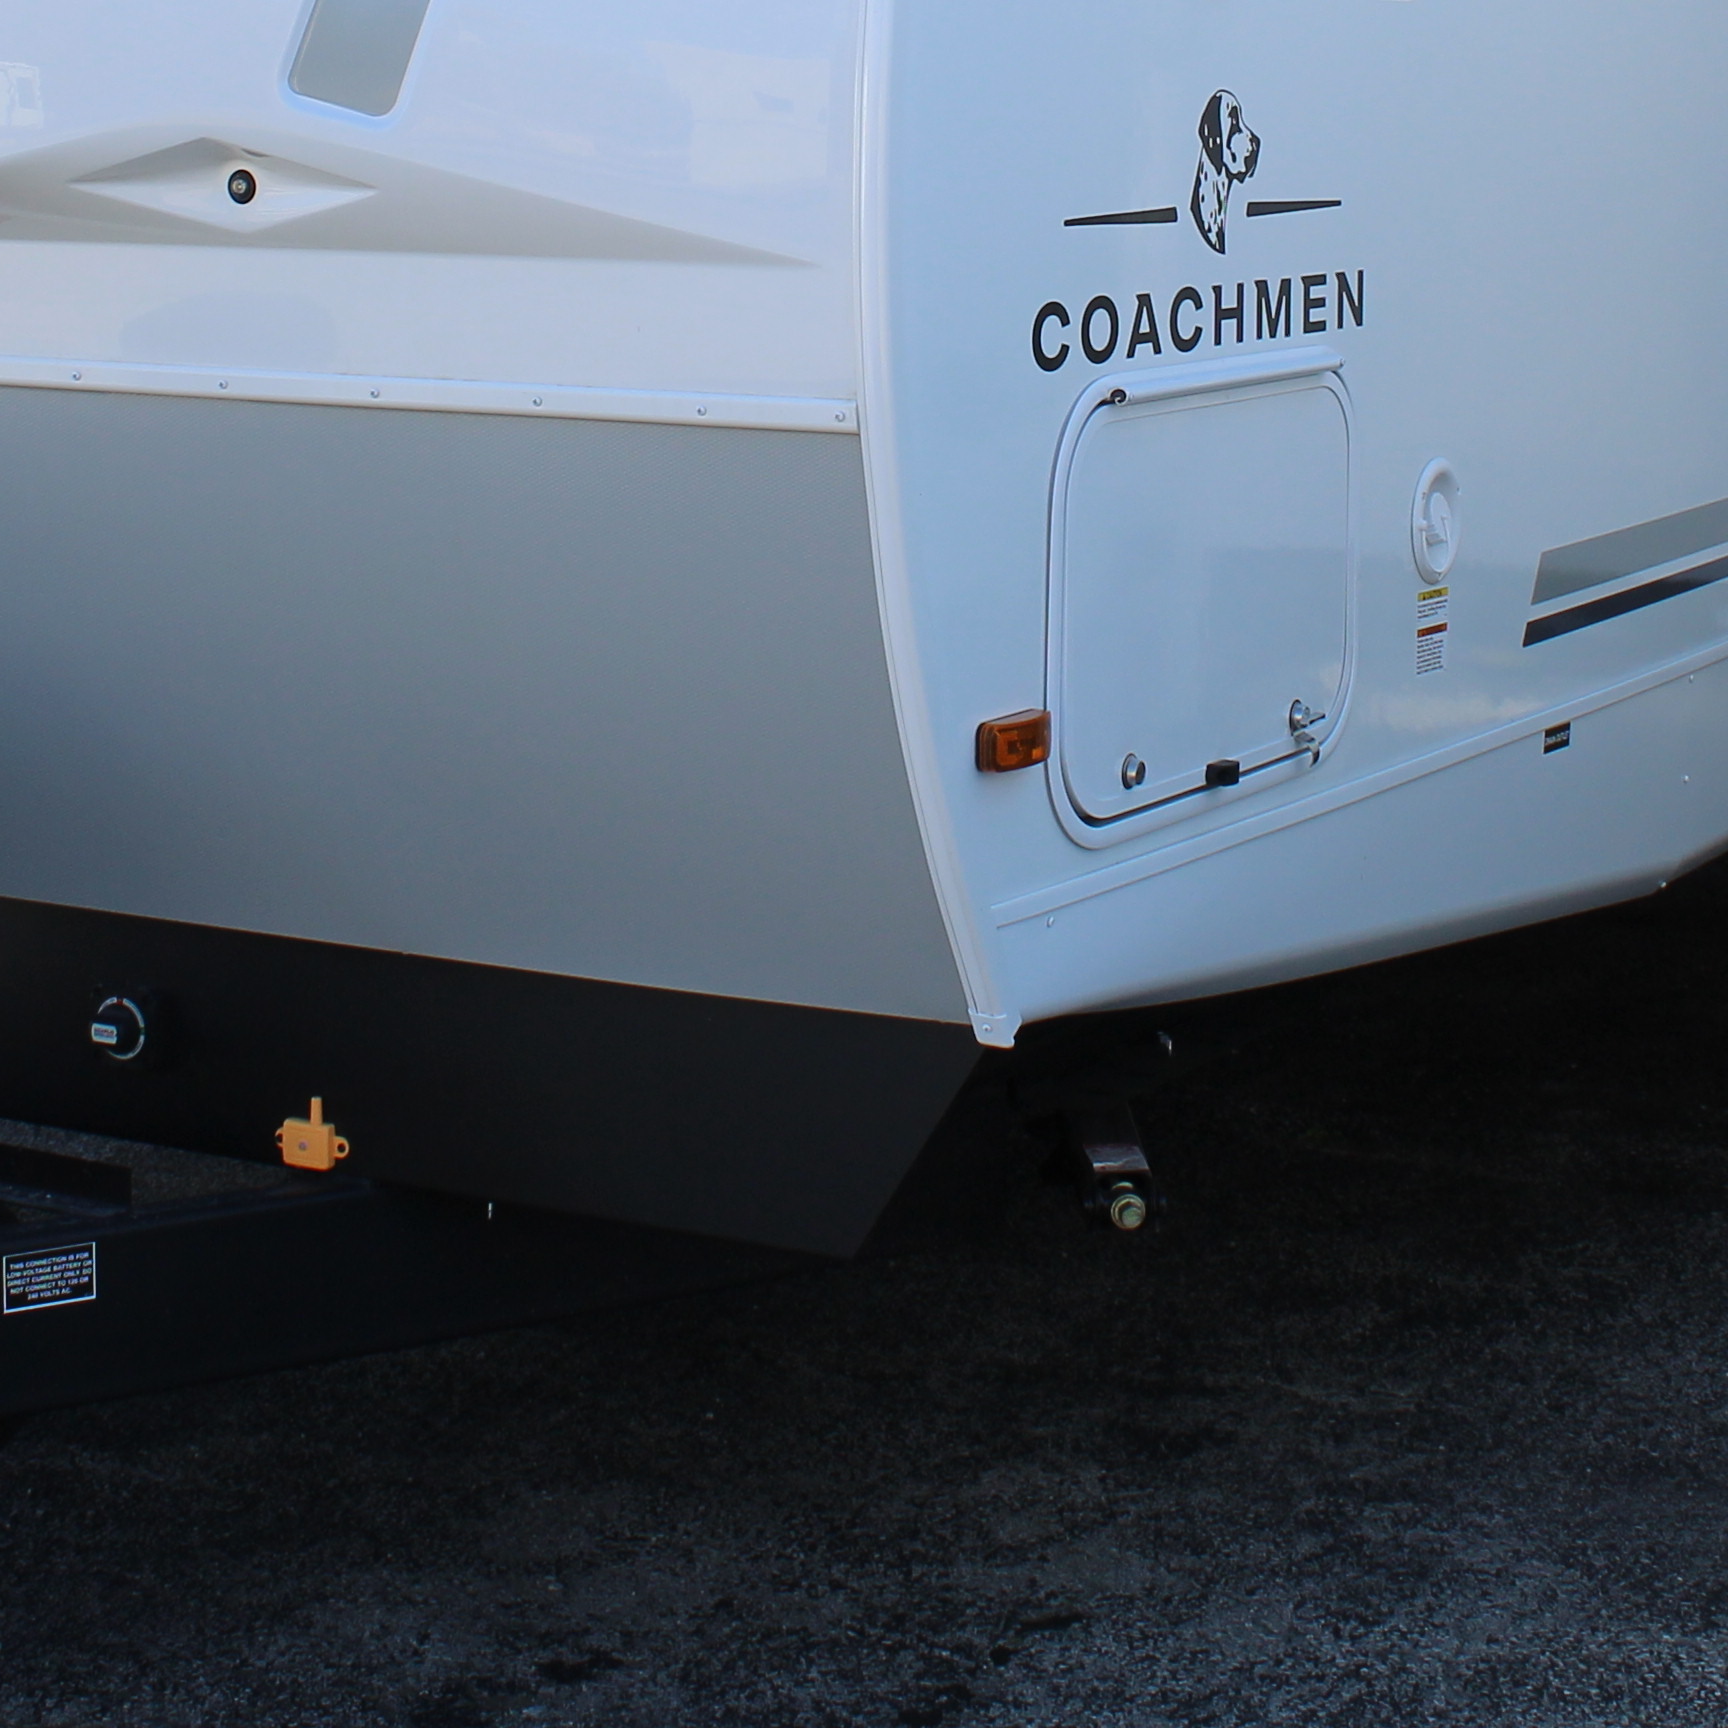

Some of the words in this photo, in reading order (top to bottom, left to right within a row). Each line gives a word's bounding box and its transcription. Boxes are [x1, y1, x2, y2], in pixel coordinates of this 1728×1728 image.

[1031, 269, 1365, 373] COACHMEN
[25, 1255, 66, 1267] CONNECTION
[53, 1260, 81, 1271] BATTERY
[7, 1277, 30, 1286] DIRECT
[31, 1272, 61, 1282] CURRENT
[25, 1281, 55, 1291] CONNECT
[39, 1288, 60, 1297] VOLTS
